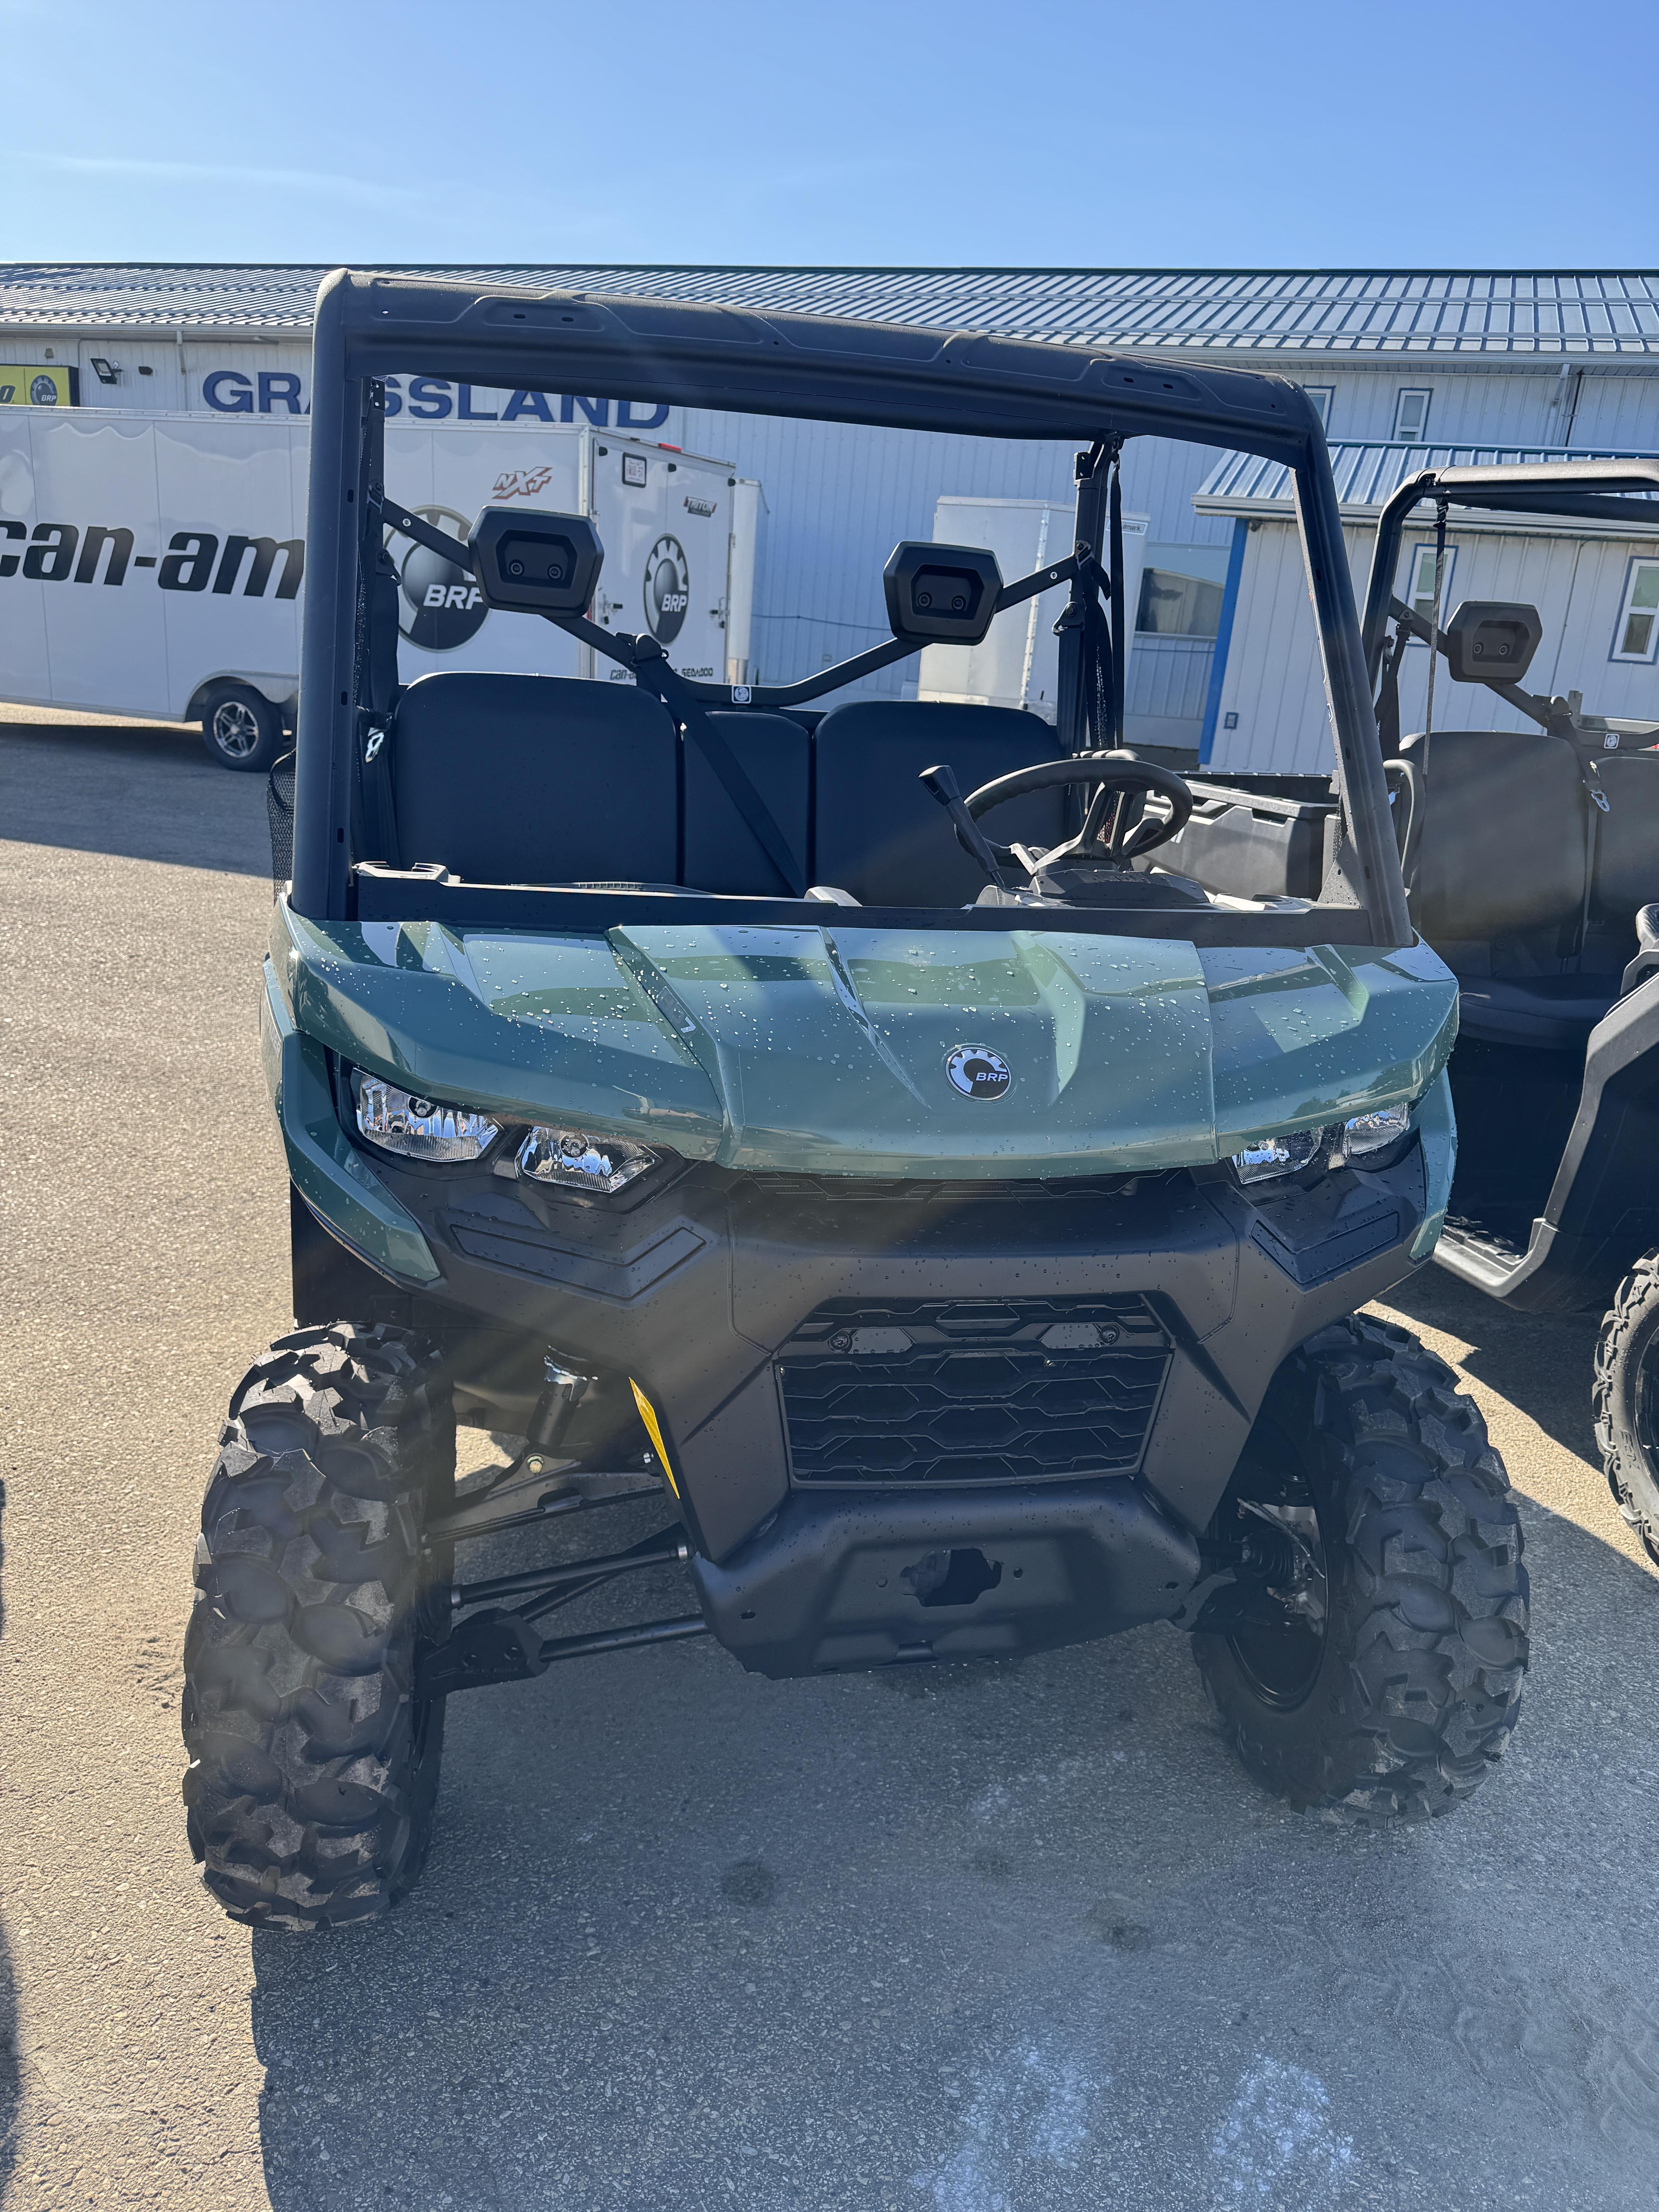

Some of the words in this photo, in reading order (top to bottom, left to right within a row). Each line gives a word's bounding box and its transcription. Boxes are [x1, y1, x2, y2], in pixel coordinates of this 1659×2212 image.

[203, 371, 670, 429] GRSLAND
[492, 467, 553, 499] NXT
[661, 594, 687, 612] BRP
[610, 670, 636, 680] can-a
[975, 1072, 1008, 1082] BRP
